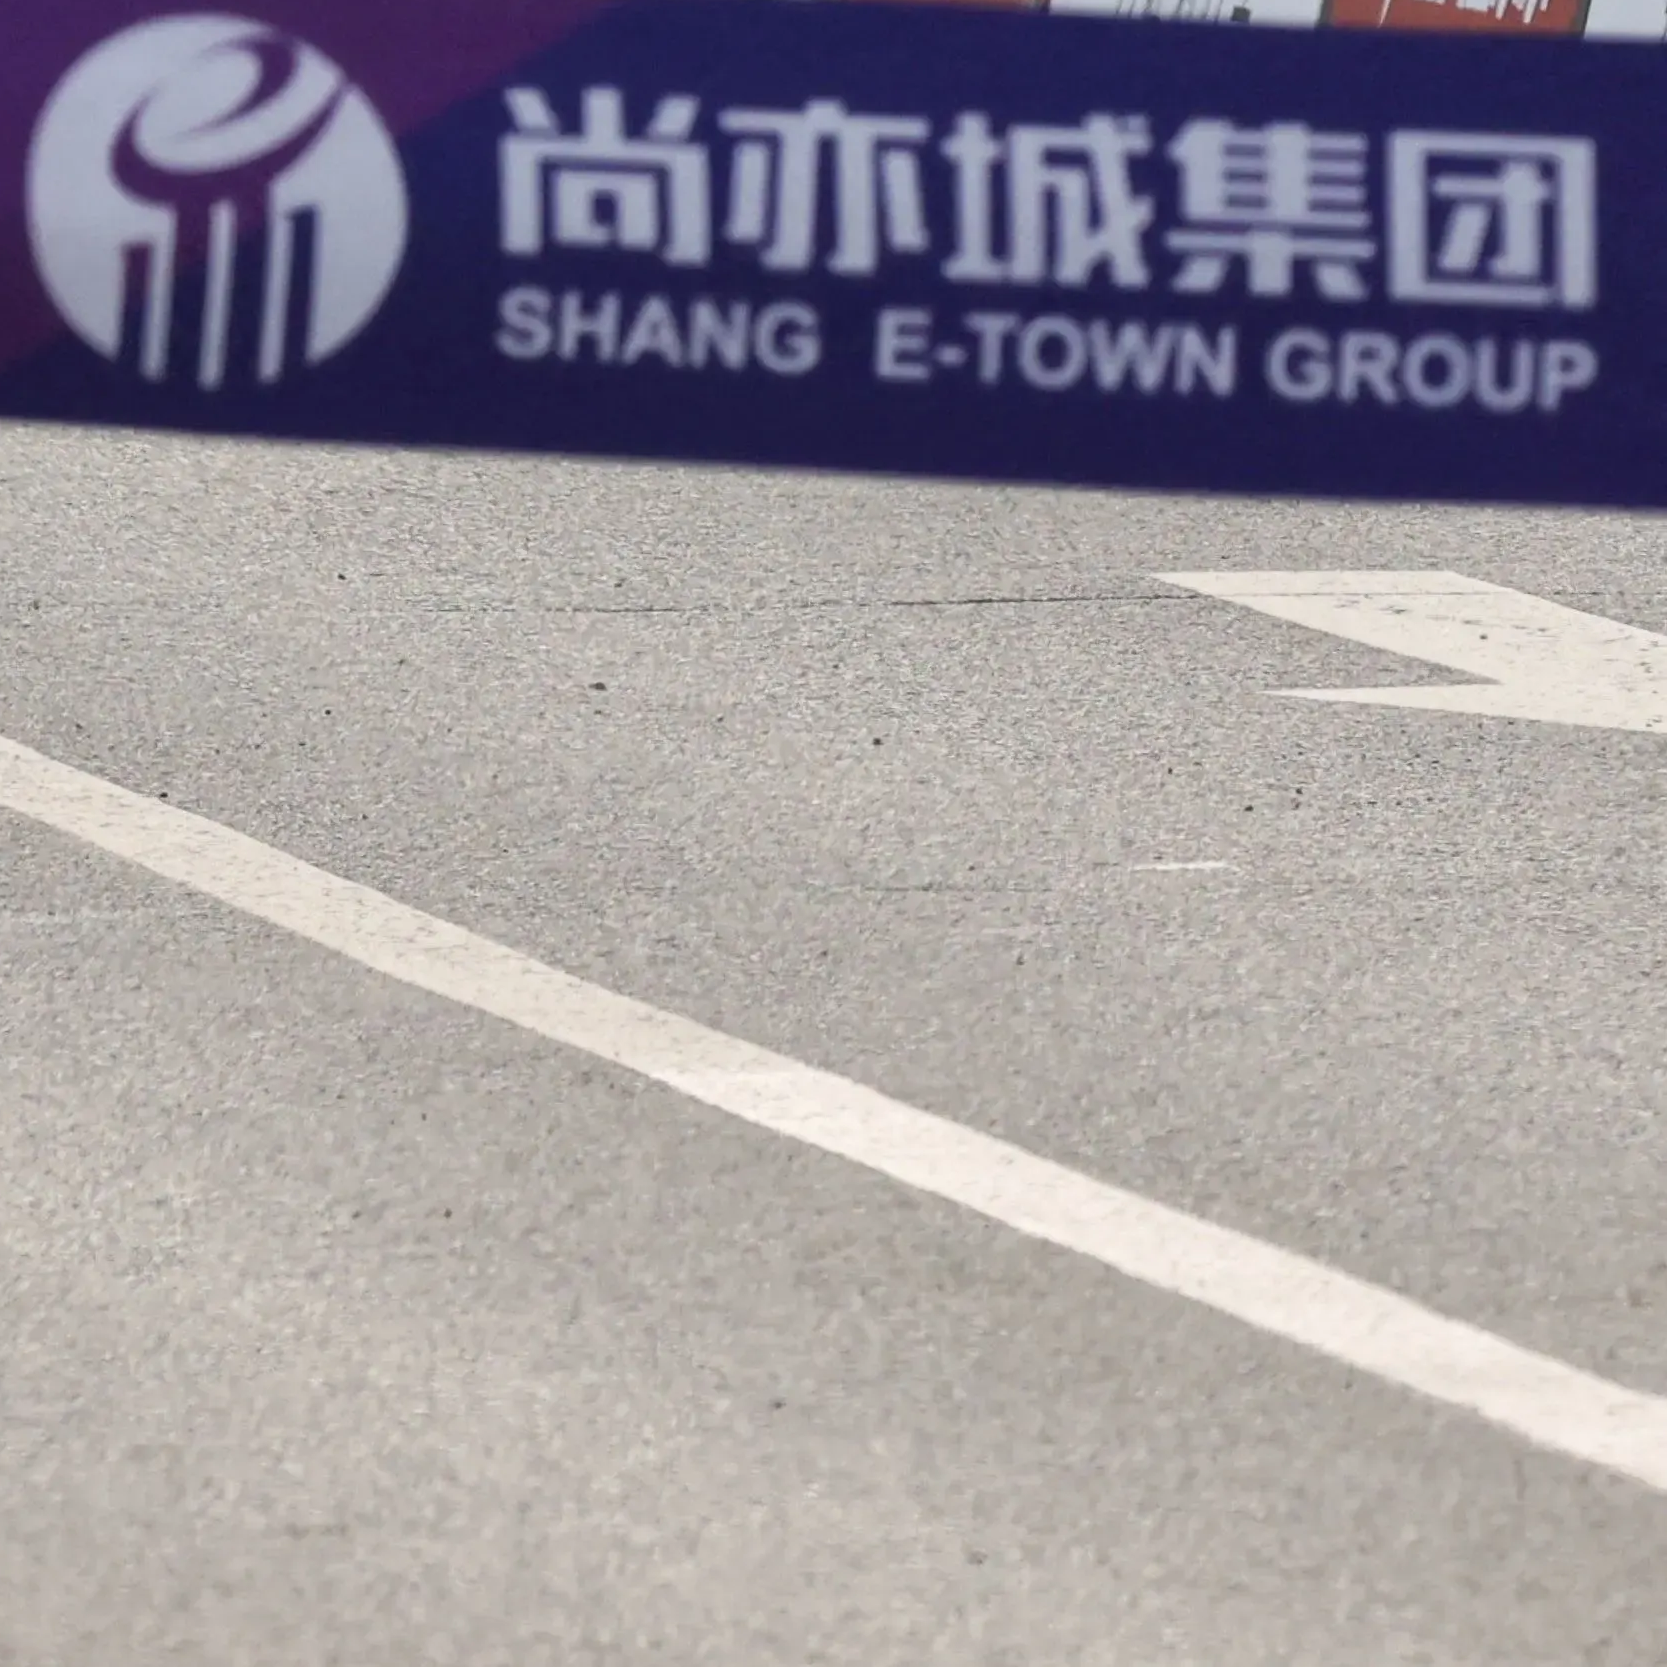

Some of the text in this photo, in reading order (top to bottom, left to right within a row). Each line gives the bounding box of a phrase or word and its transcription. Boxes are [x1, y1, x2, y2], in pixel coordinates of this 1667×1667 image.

[497, 82, 1601, 311] 尚亦城集团
[495, 283, 1599, 415] SHANG E-TOWN GROUP
